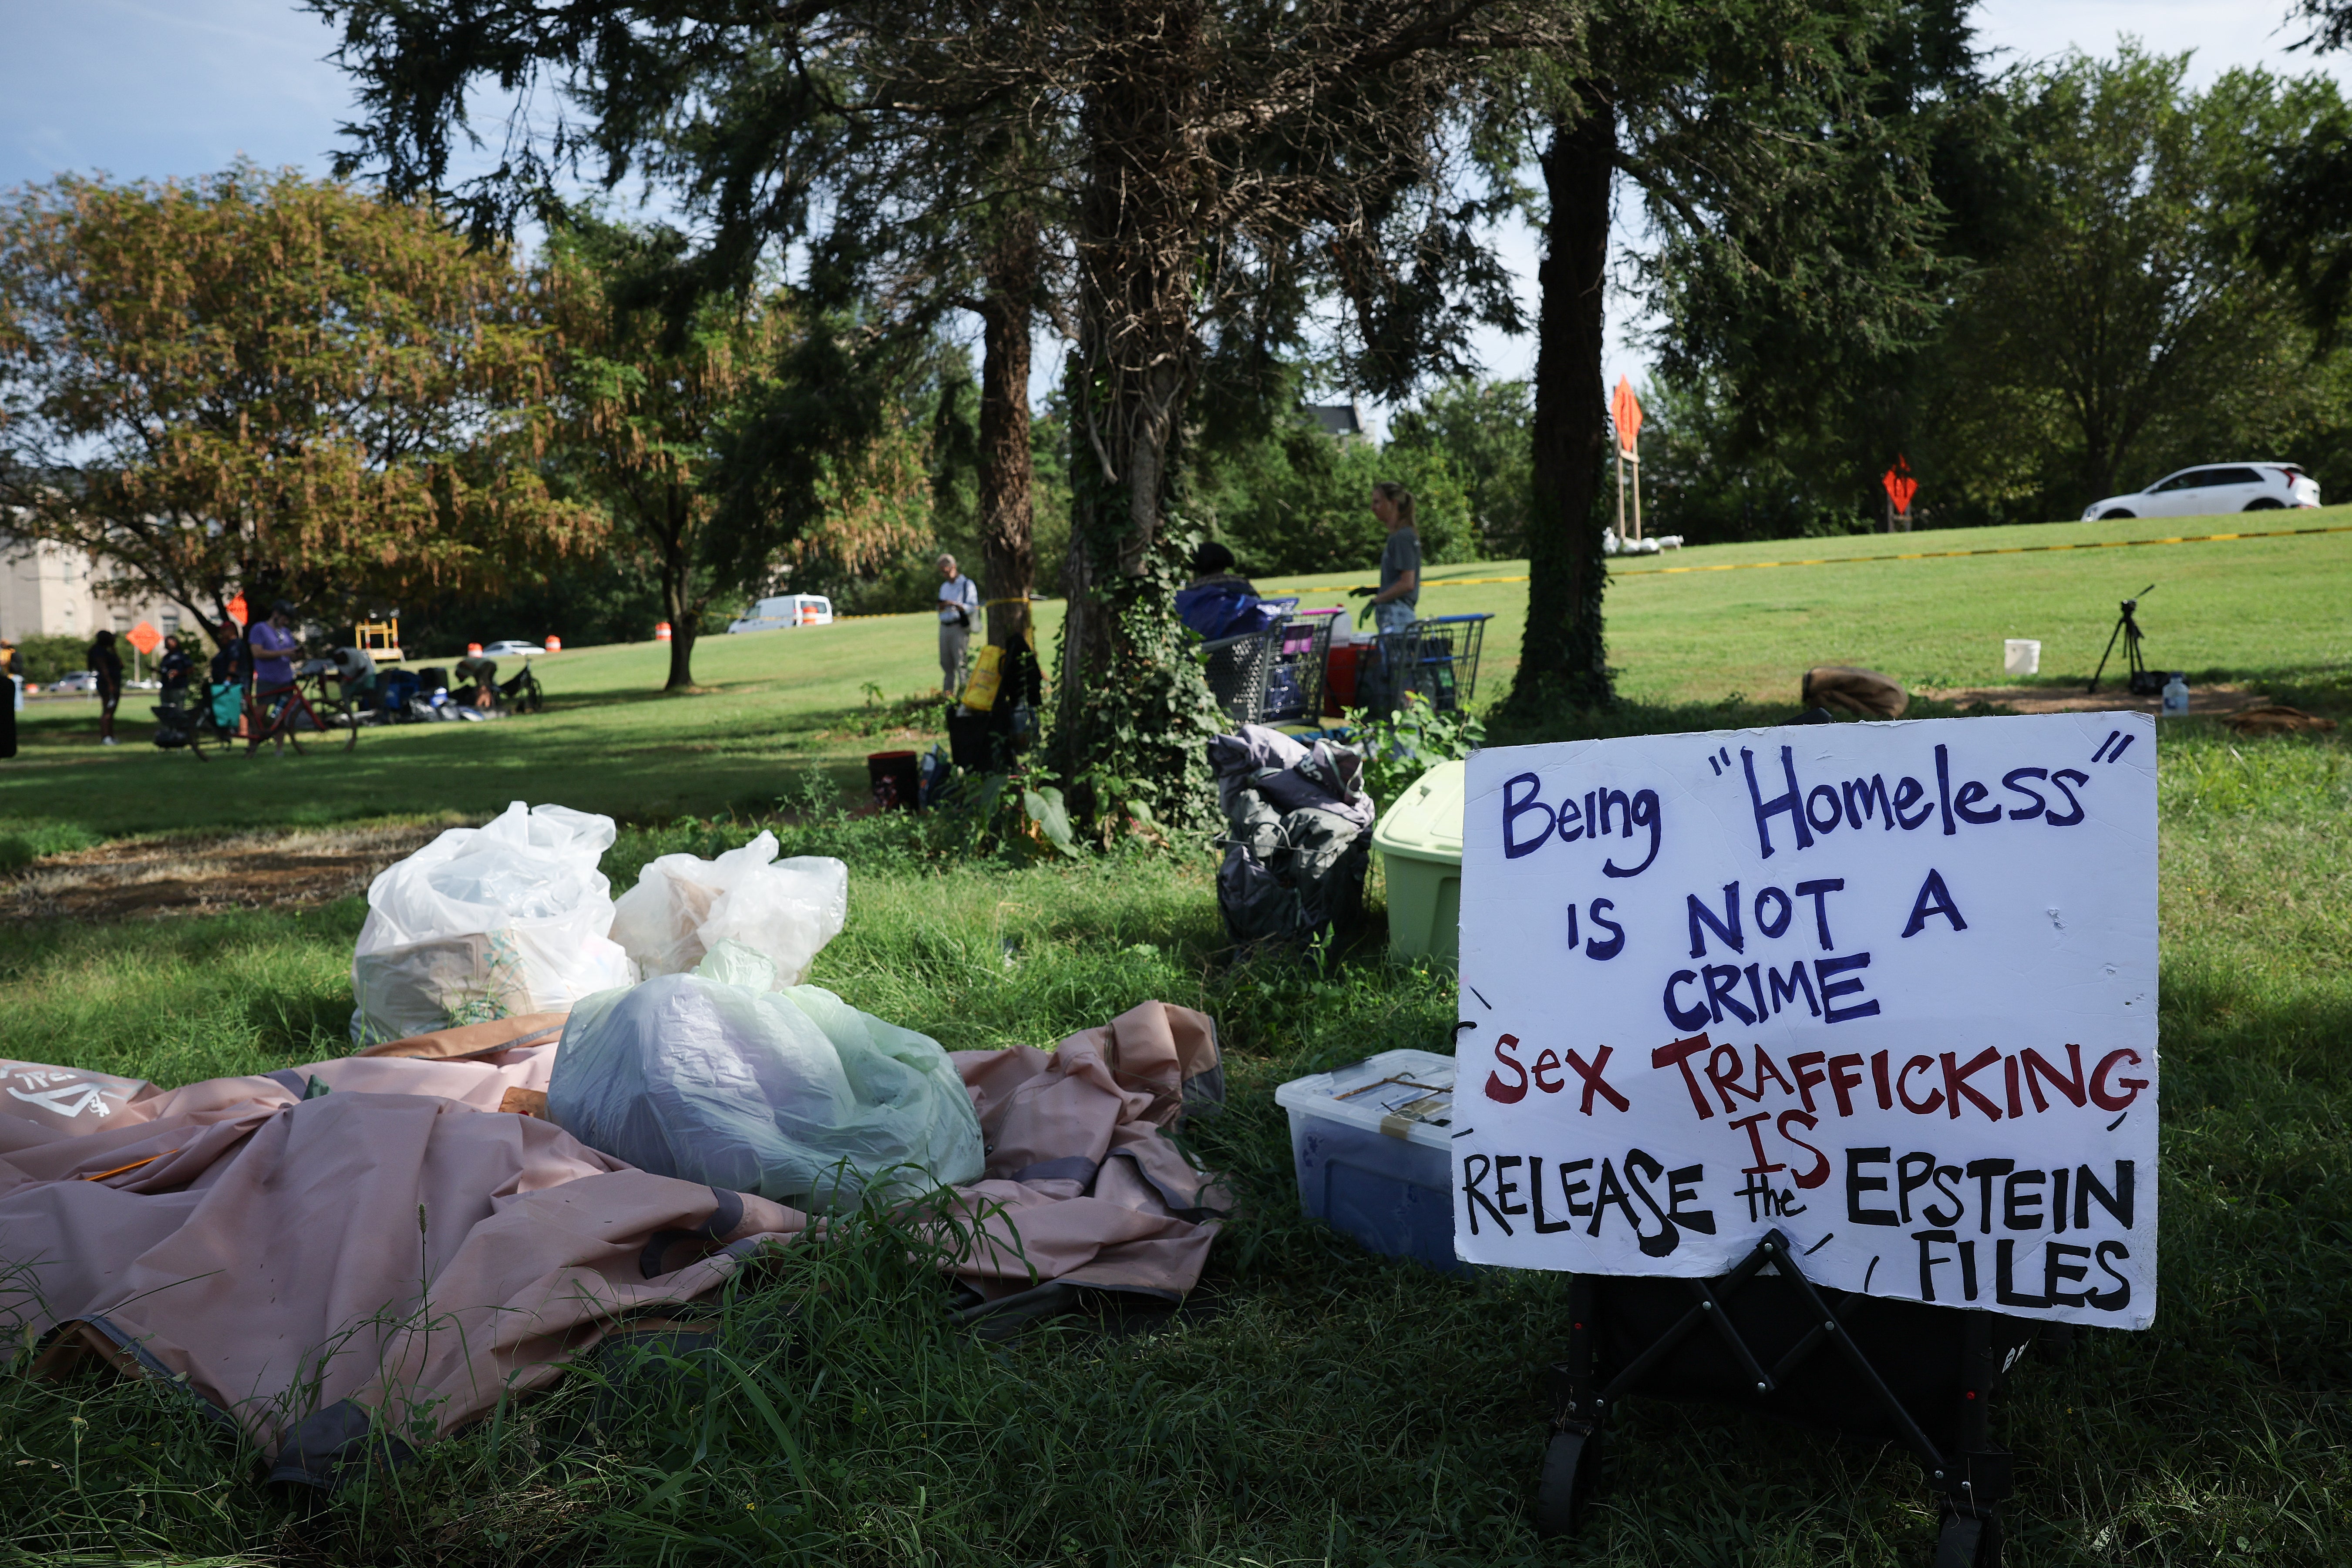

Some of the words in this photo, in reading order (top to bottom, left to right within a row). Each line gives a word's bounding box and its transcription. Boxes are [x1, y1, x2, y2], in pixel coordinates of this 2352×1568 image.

[1503, 773, 1661, 878] Being
[1709, 730, 2135, 859] "Homeless"
[1568, 898, 1625, 961] IS
[1687, 878, 1844, 959] NOT
[1901, 868, 1968, 938] A
[1663, 952, 1880, 1032] CRIME
[1652, 1032, 2149, 1122] TRAFFICKING
[1728, 1109, 1830, 1189] IS
[1462, 1148, 1716, 1258] RELEASE
[1733, 1173, 1807, 1223] the
[1845, 1147, 2135, 1235] EPSTEIN
[1911, 1230, 2130, 1311] FILES
